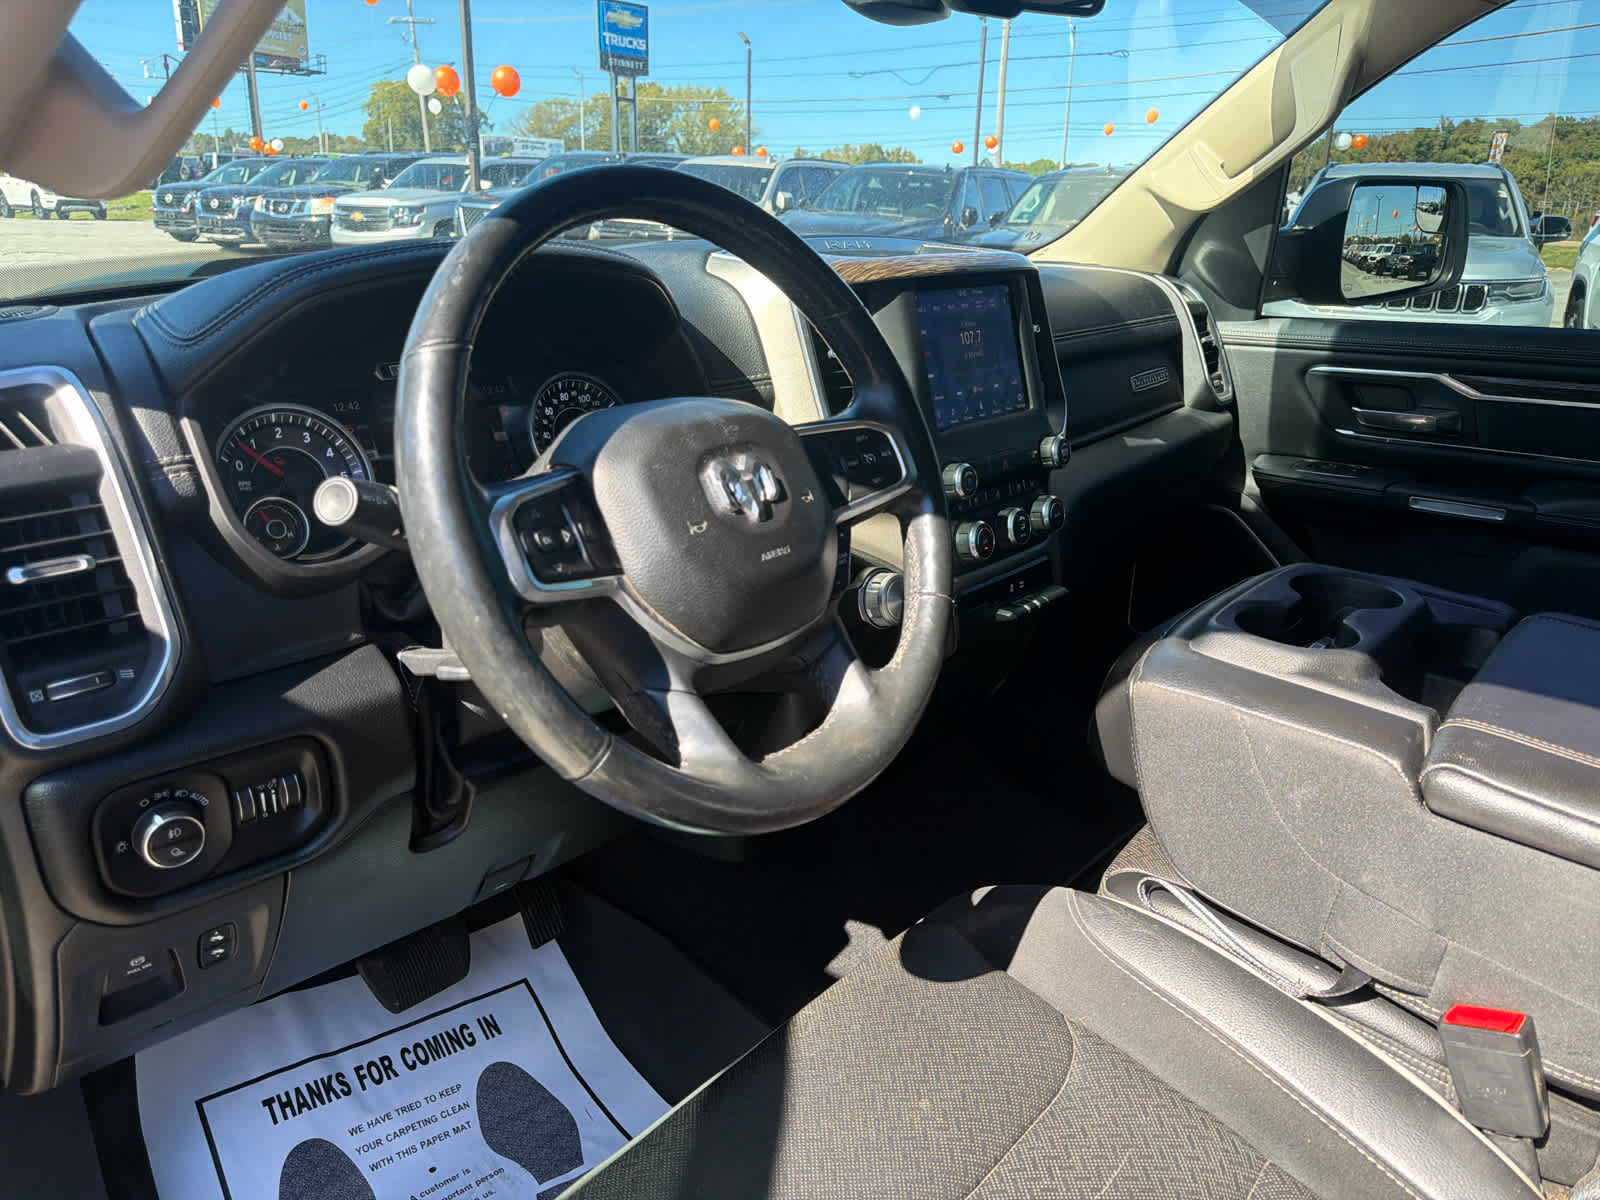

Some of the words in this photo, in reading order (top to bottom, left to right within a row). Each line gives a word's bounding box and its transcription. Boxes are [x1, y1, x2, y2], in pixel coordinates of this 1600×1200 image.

[603, 32, 646, 50] TRUCKS
[959, 330, 981, 345] 107.7
[560, 393, 569, 401] 80
[578, 394, 591, 403] 100
[333, 400, 360, 412] 12:42
[544, 407, 554, 416] 60
[275, 427, 283, 438] 2
[303, 432, 311, 443] 3
[250, 439, 257, 449] 1
[326, 447, 334, 457] 4
[235, 460, 243, 471] 0
[189, 791, 209, 807] AUTO
[261, 1071, 352, 1125] THANKS
[353, 1055, 400, 1091] FOR
[399, 1023, 478, 1071] COMING
[476, 1014, 504, 1041] IN
[347, 1123, 366, 1137] WE
[367, 1112, 394, 1130] HAVE
[394, 1100, 422, 1117] TRIED
[423, 1094, 437, 1105] TO
[438, 1083, 462, 1099] KEEP
[355, 1138, 384, 1155] YOUR
[385, 1115, 438, 1143] CARPETING
[439, 1101, 471, 1120] CLEAN
[368, 1155, 394, 1172] WITH
[395, 1145, 418, 1161] THIS
[419, 1130, 452, 1150] PAPER
[452, 1120, 473, 1136] MAT
[419, 1172, 460, 1198] customer
[462, 1168, 472, 1176] is
[475, 1167, 505, 1187] person
